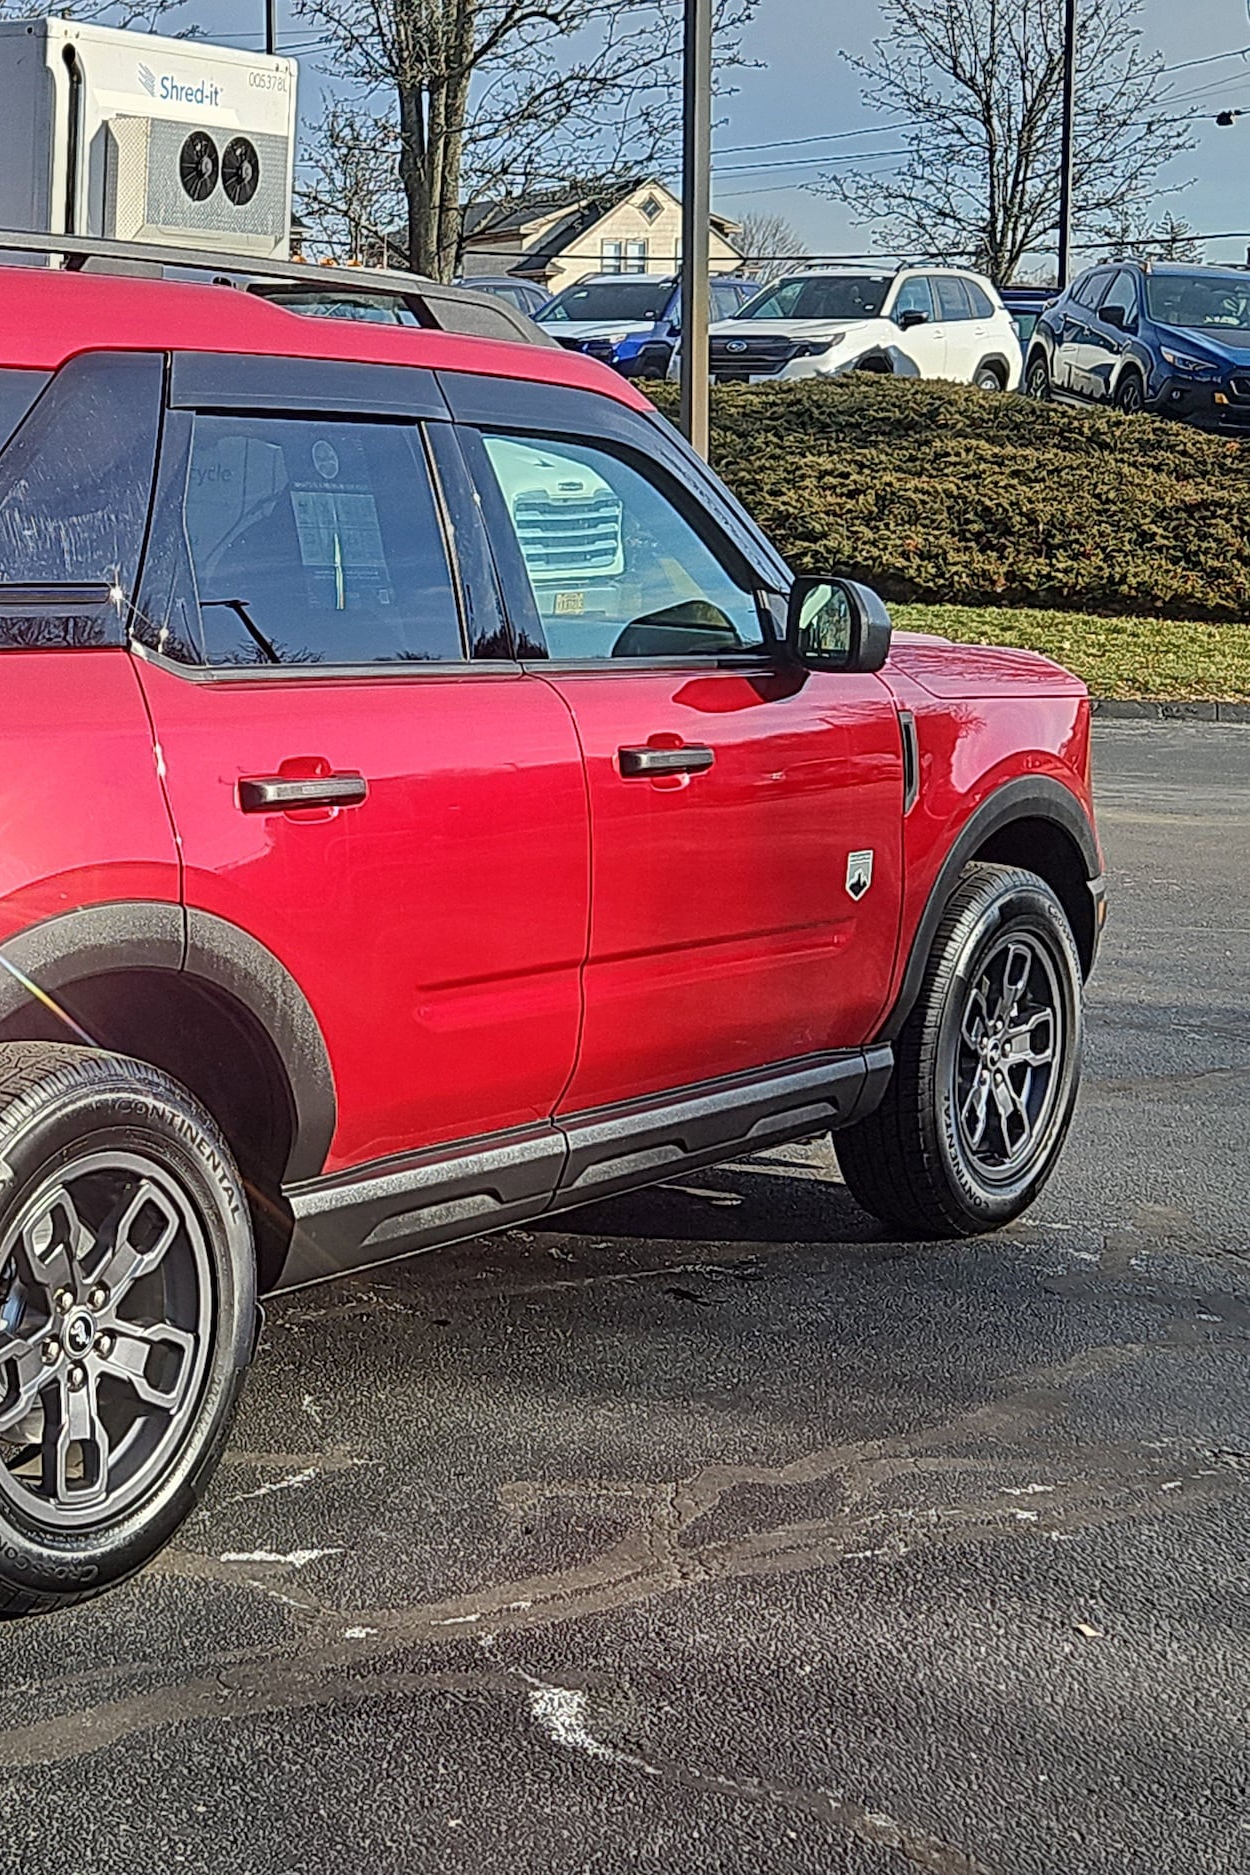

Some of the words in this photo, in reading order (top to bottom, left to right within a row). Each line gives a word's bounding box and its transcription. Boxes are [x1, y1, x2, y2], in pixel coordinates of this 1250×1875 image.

[160, 76, 219, 106] Shred-it
[115, 1099, 241, 1225] CONTINENTAL
[943, 1087, 990, 1209] CONTINENTAL
